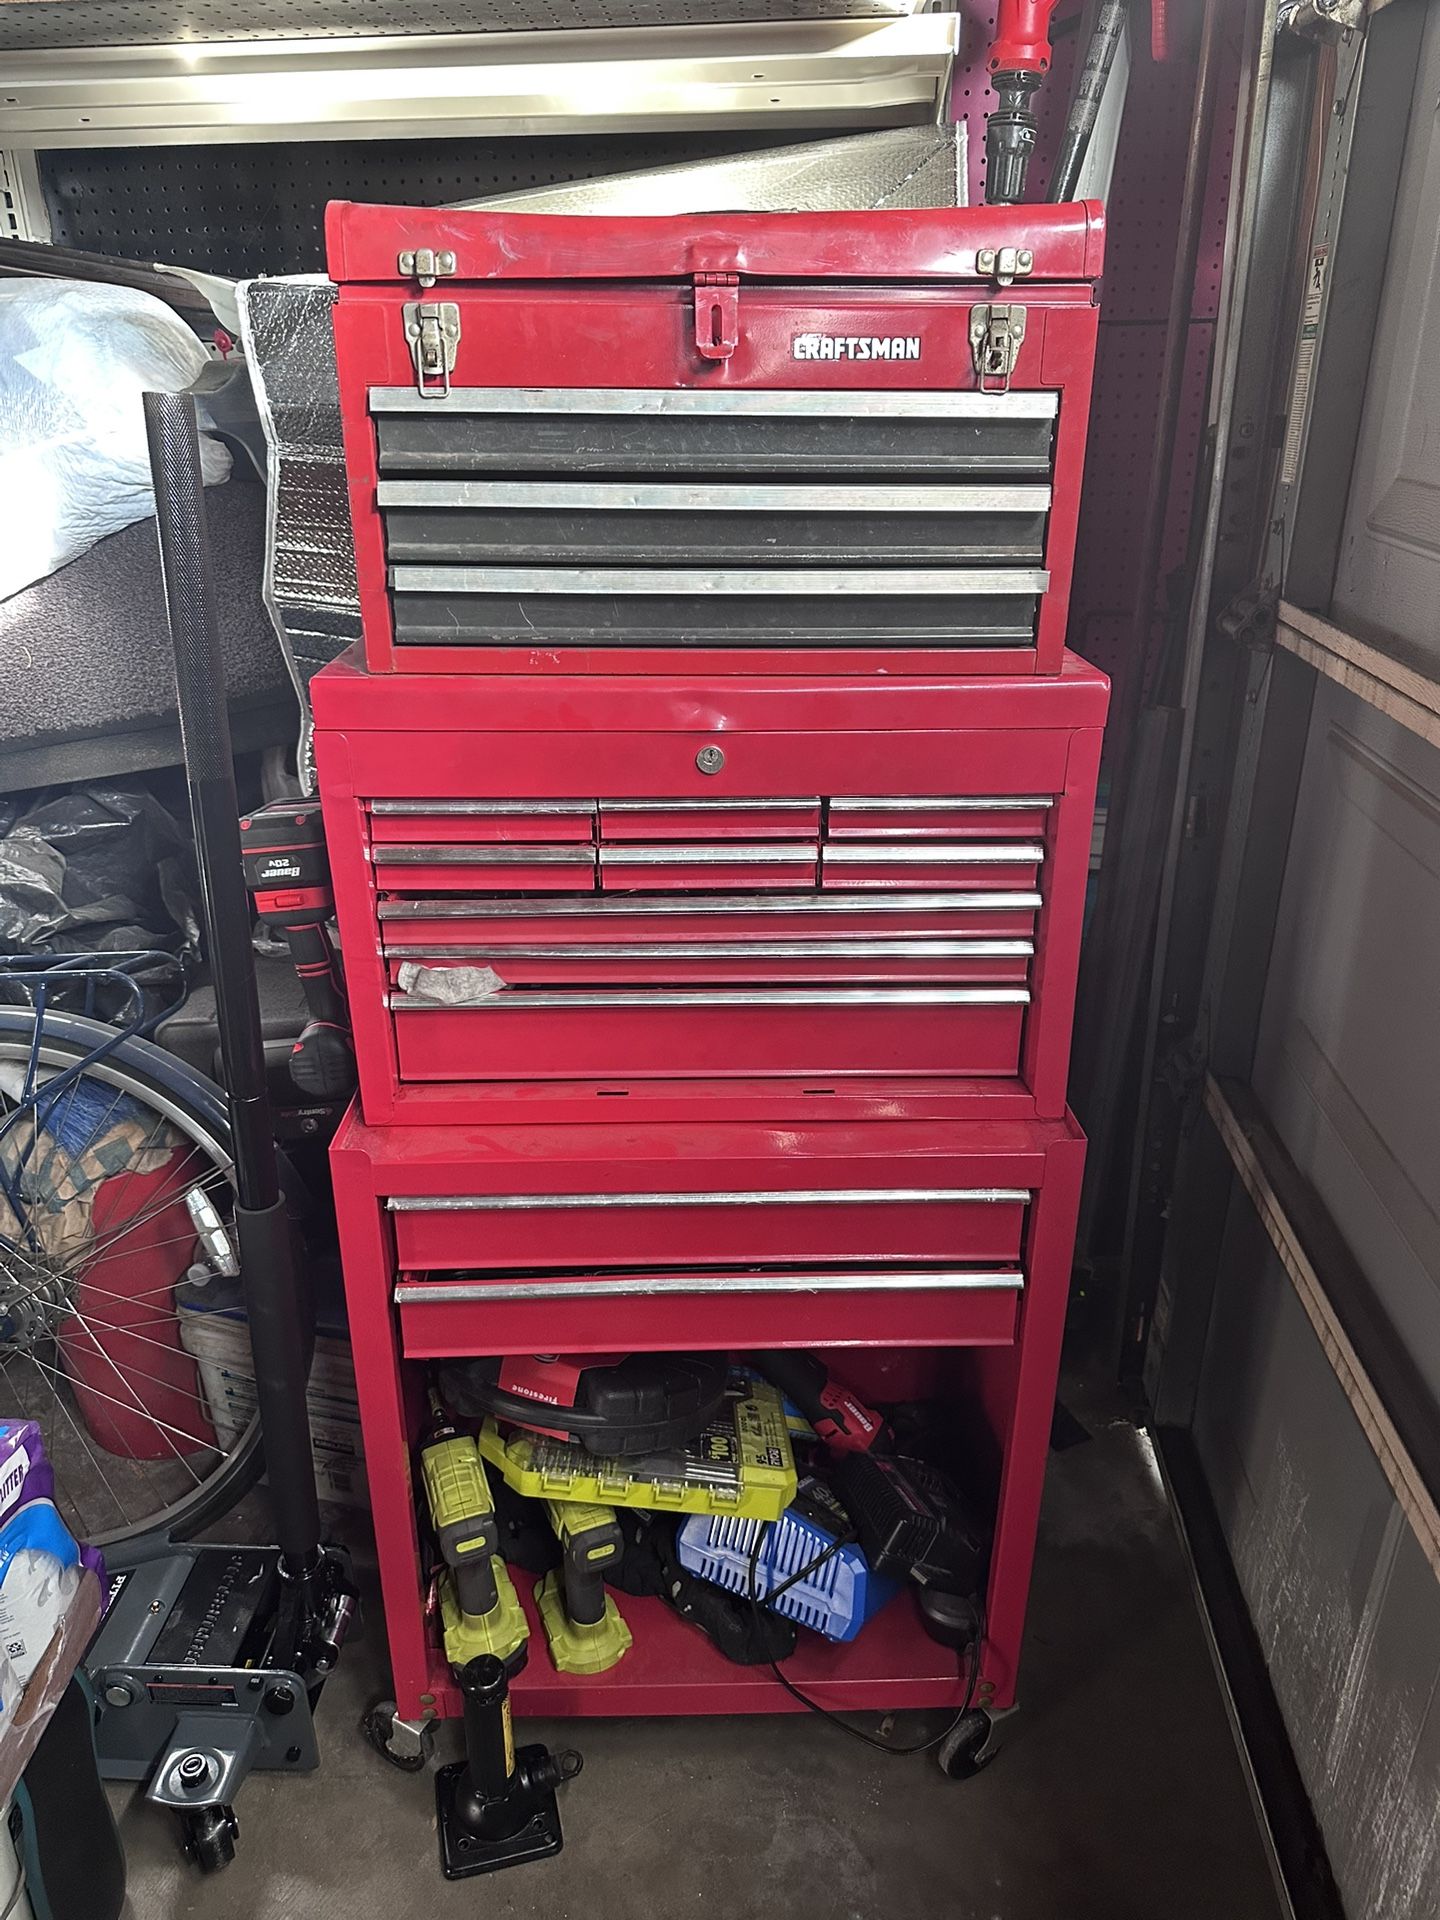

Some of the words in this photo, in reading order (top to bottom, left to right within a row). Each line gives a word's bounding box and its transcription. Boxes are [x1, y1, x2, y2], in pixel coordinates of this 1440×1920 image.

[793, 335, 920, 360] CRAFTSMAN
[261, 867, 300, 878] Bauer
[512, 1385, 558, 1405] Firestone
